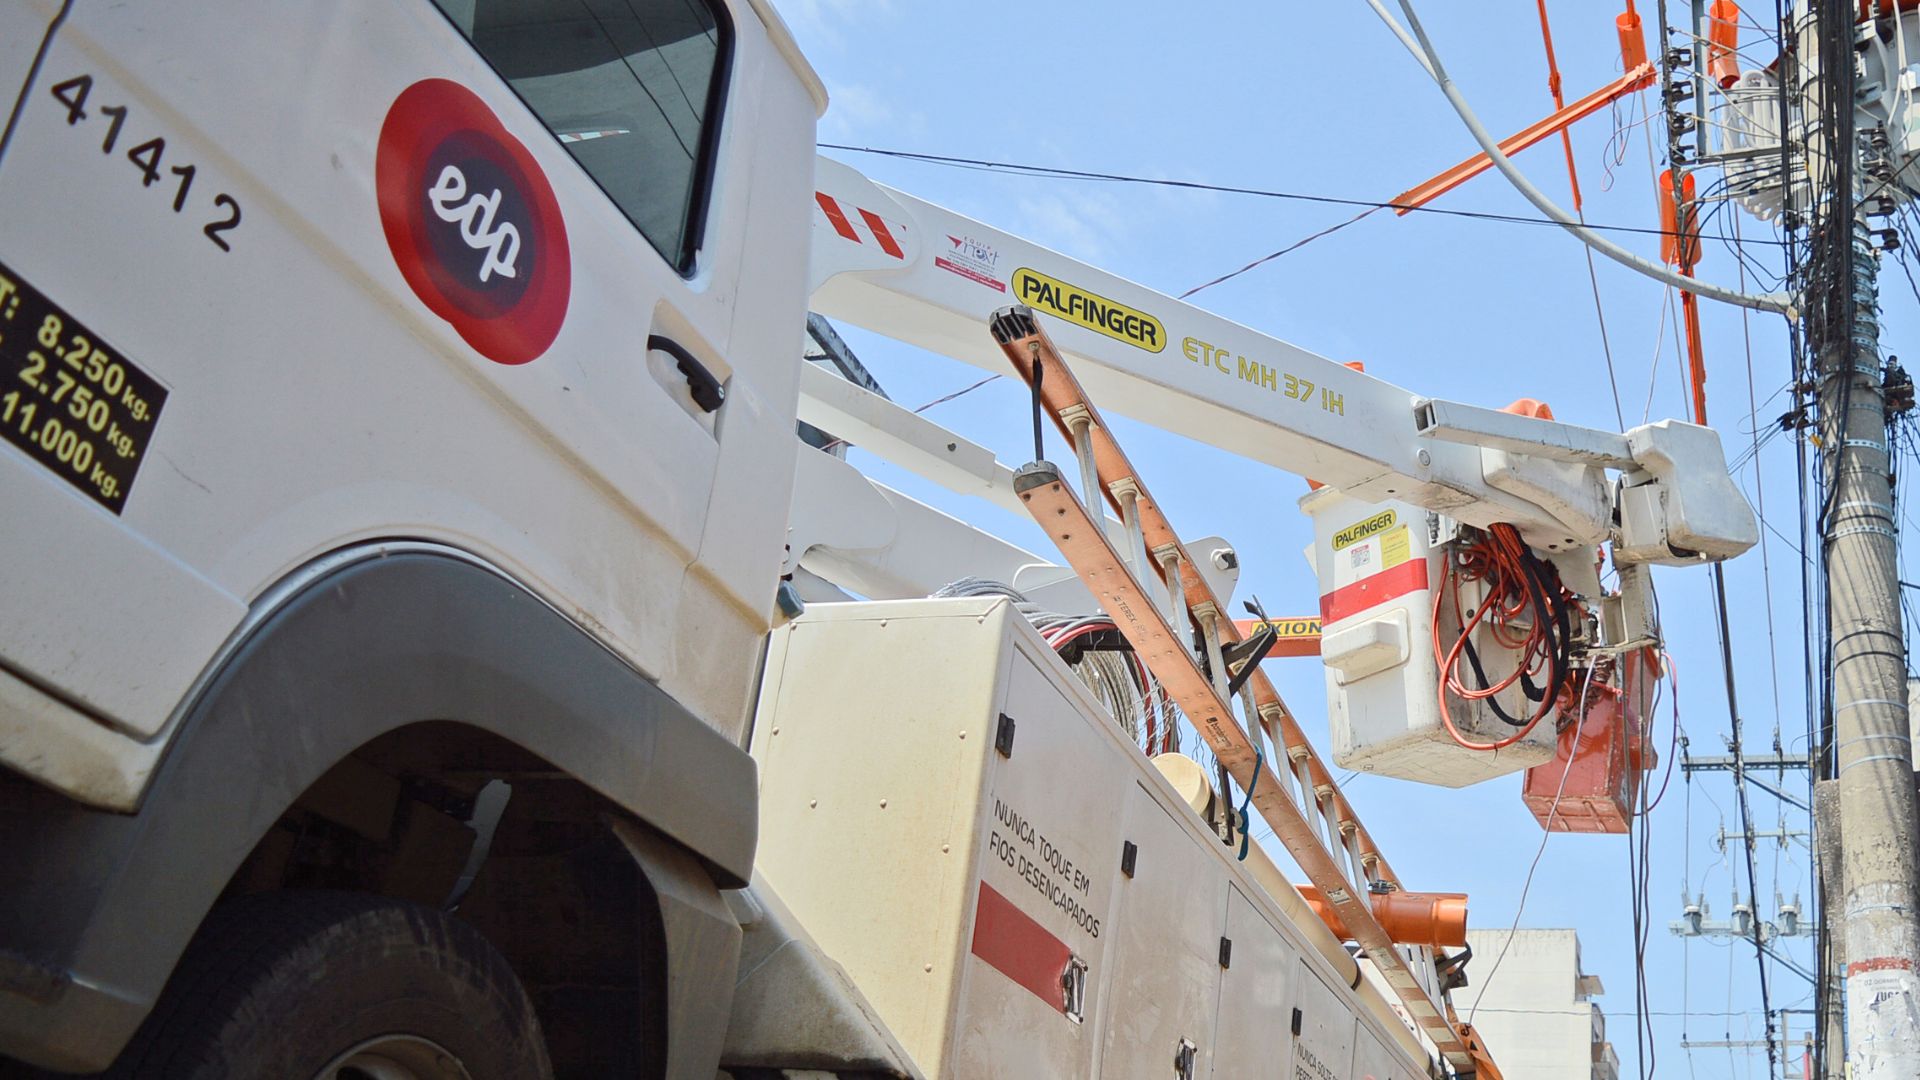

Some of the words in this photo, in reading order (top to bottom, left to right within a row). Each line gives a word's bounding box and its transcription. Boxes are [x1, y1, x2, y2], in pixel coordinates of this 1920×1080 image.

[51, 74, 241, 252] 41412
[428, 165, 520, 282] edp
[1023, 275, 1156, 346] PALFINGER
[19, 351, 110, 432] 2.750
[107, 422, 136, 458] kg.
[37, 314, 124, 396] 8.250
[121, 385, 150, 421] kg.
[1182, 336, 1230, 374] ETC
[1238, 356, 1277, 392] MH
[1284, 373, 1314, 402] 37
[2, 391, 93, 474] 11.000
[90, 462, 120, 498] kg.
[1336, 513, 1392, 548] PALFINGER
[990, 830, 1016, 868] FIOS
[1018, 855, 1100, 938] DESENCAPADOS
[995, 799, 1036, 850] NUNCA
[1039, 836, 1073, 883] TOQUE
[1074, 869, 1090, 897] EM
[1297, 1042, 1317, 1070] NUNCA
